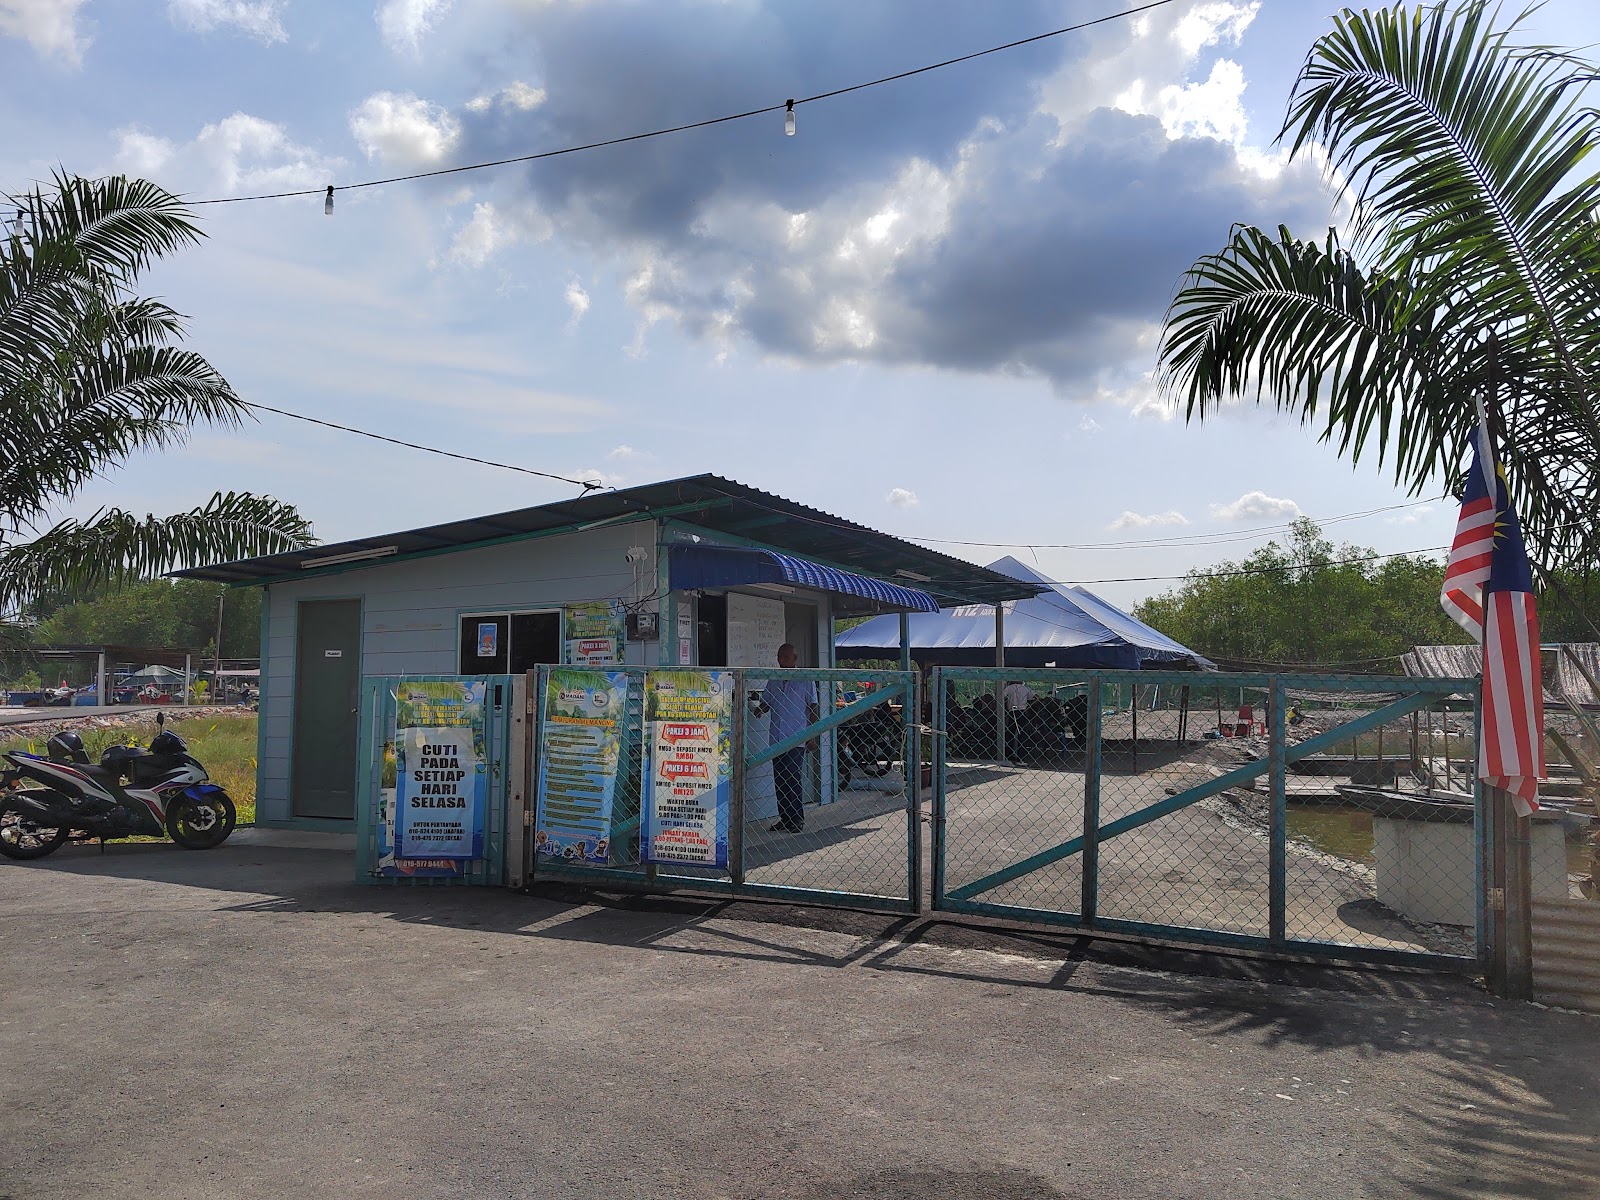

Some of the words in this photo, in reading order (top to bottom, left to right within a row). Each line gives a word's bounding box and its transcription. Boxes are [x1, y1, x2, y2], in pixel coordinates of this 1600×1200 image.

[666, 727, 684, 735] PAKEJ
[422, 744, 458, 756] CUTI
[420, 758, 460, 768] PADA
[414, 770, 466, 782] SETIAP
[421, 784, 457, 794] HARI
[412, 796, 466, 808] SELASA
